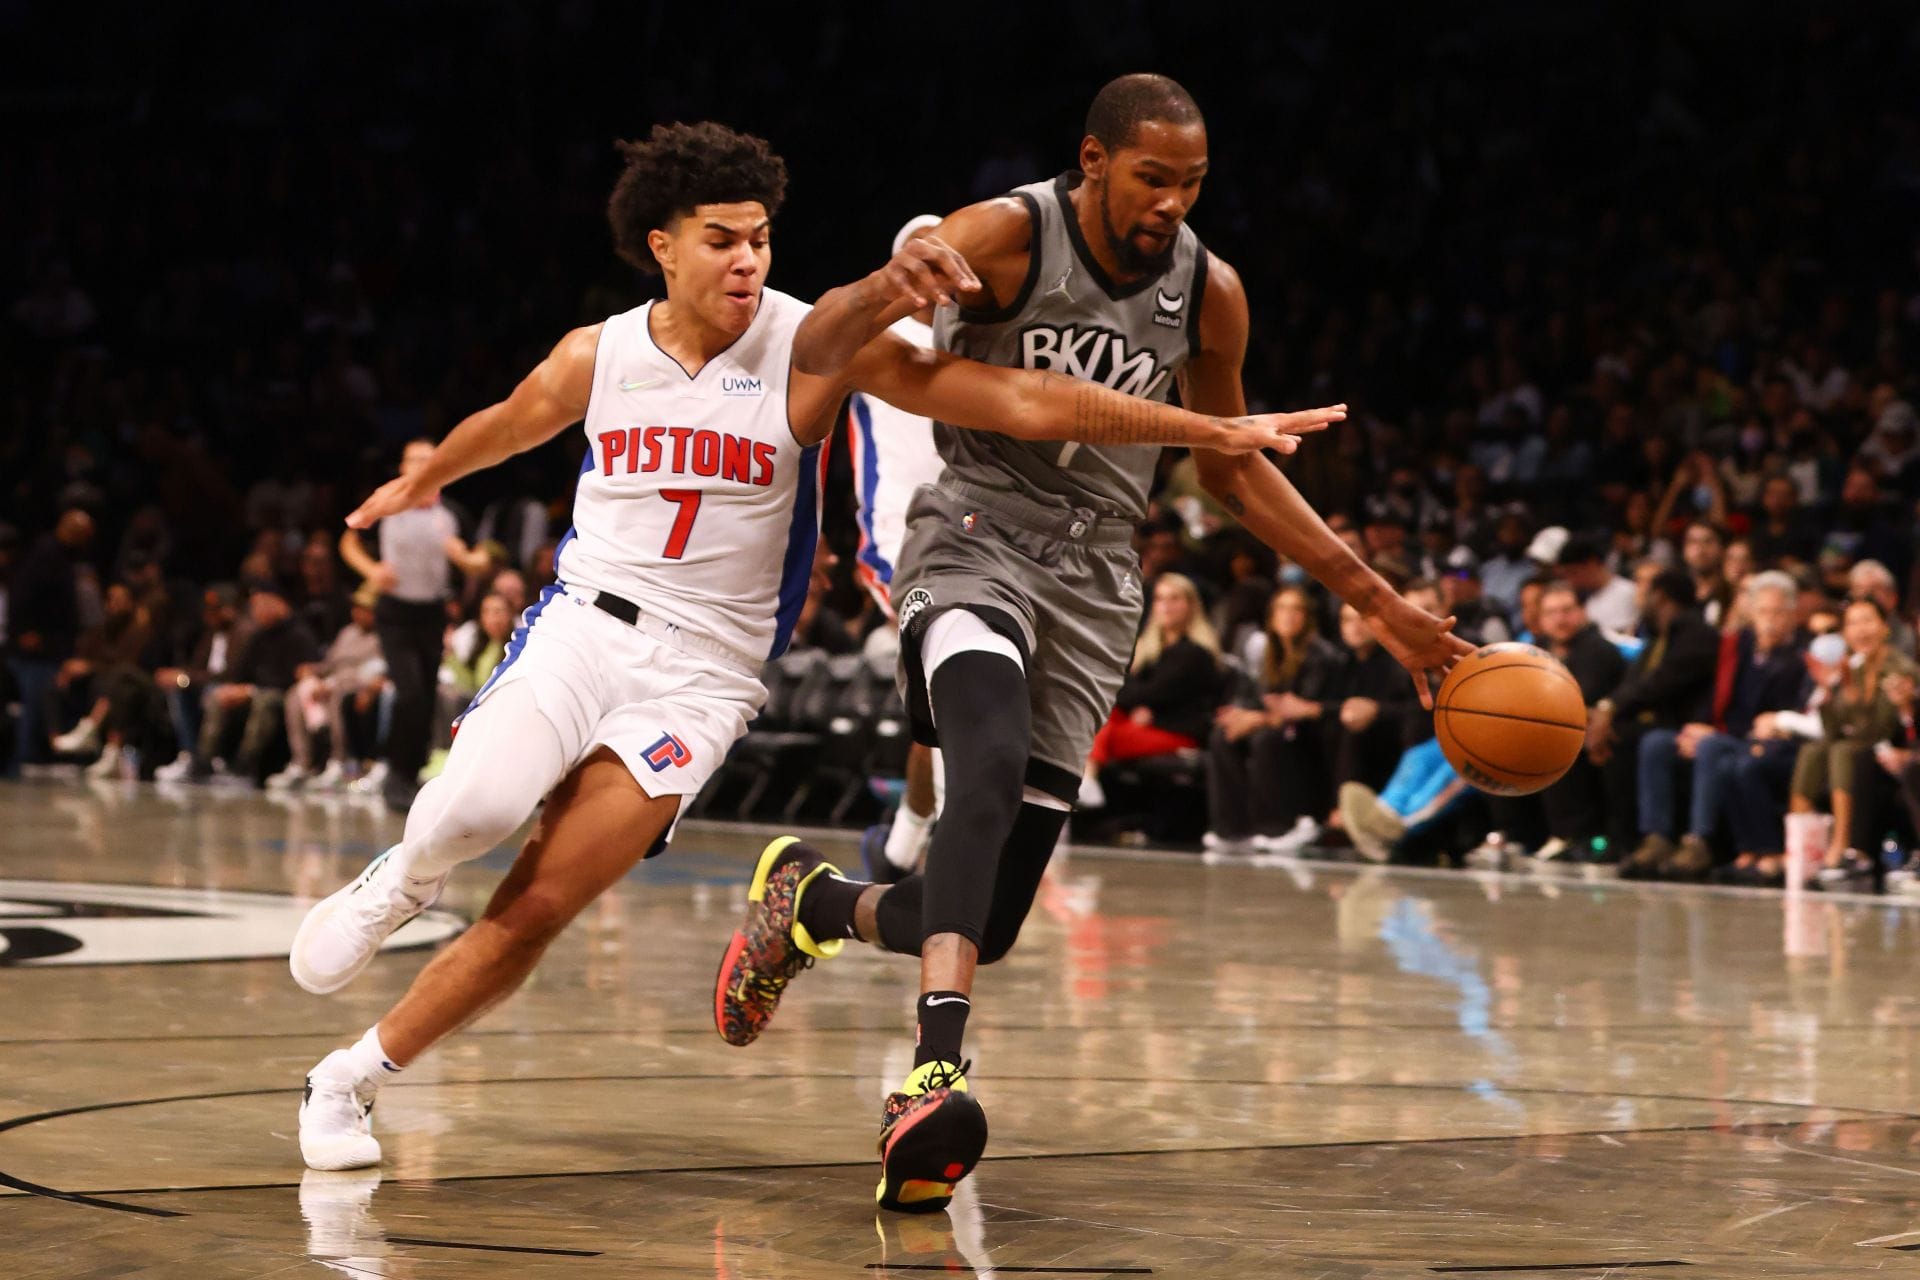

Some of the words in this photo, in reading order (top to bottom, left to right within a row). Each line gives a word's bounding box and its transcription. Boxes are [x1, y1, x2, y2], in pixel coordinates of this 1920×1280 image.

[722, 377, 762, 391] UWM
[597, 426, 777, 487] PISTONS
[658, 488, 703, 560] 7
